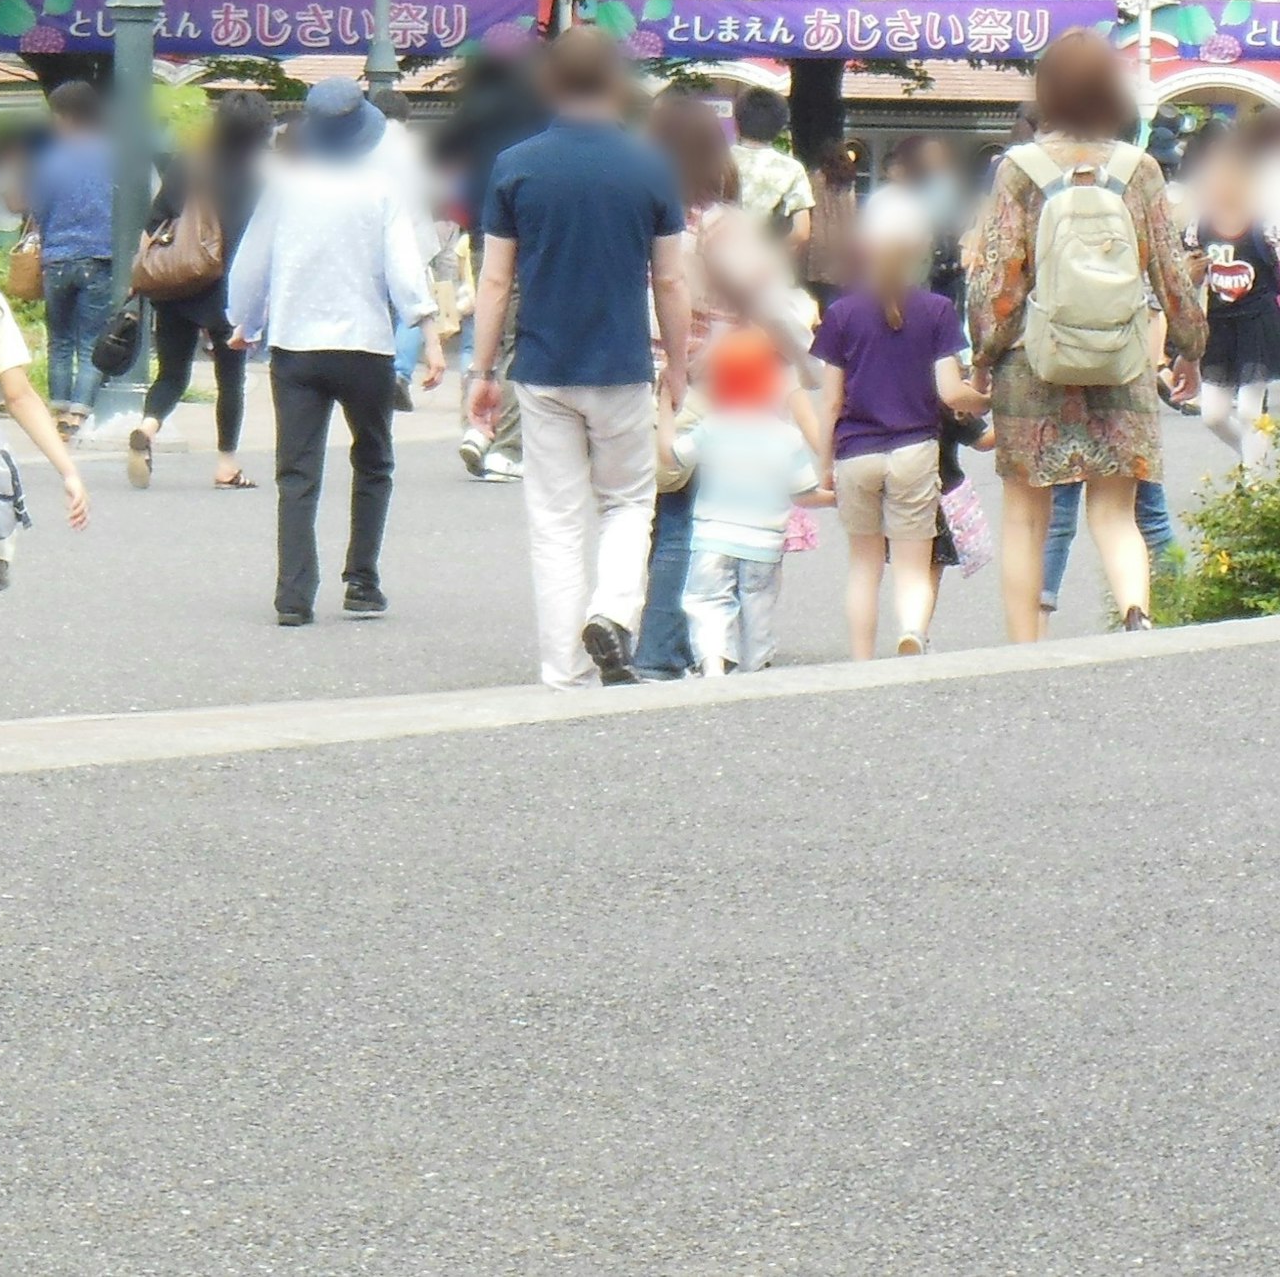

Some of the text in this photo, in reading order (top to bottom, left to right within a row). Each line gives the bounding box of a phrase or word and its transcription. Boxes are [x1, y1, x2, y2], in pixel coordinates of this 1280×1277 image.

[70, 3, 467, 48] としえん あじさい祭り
[667, 8, 1050, 53] としまえん あじさい祭り
